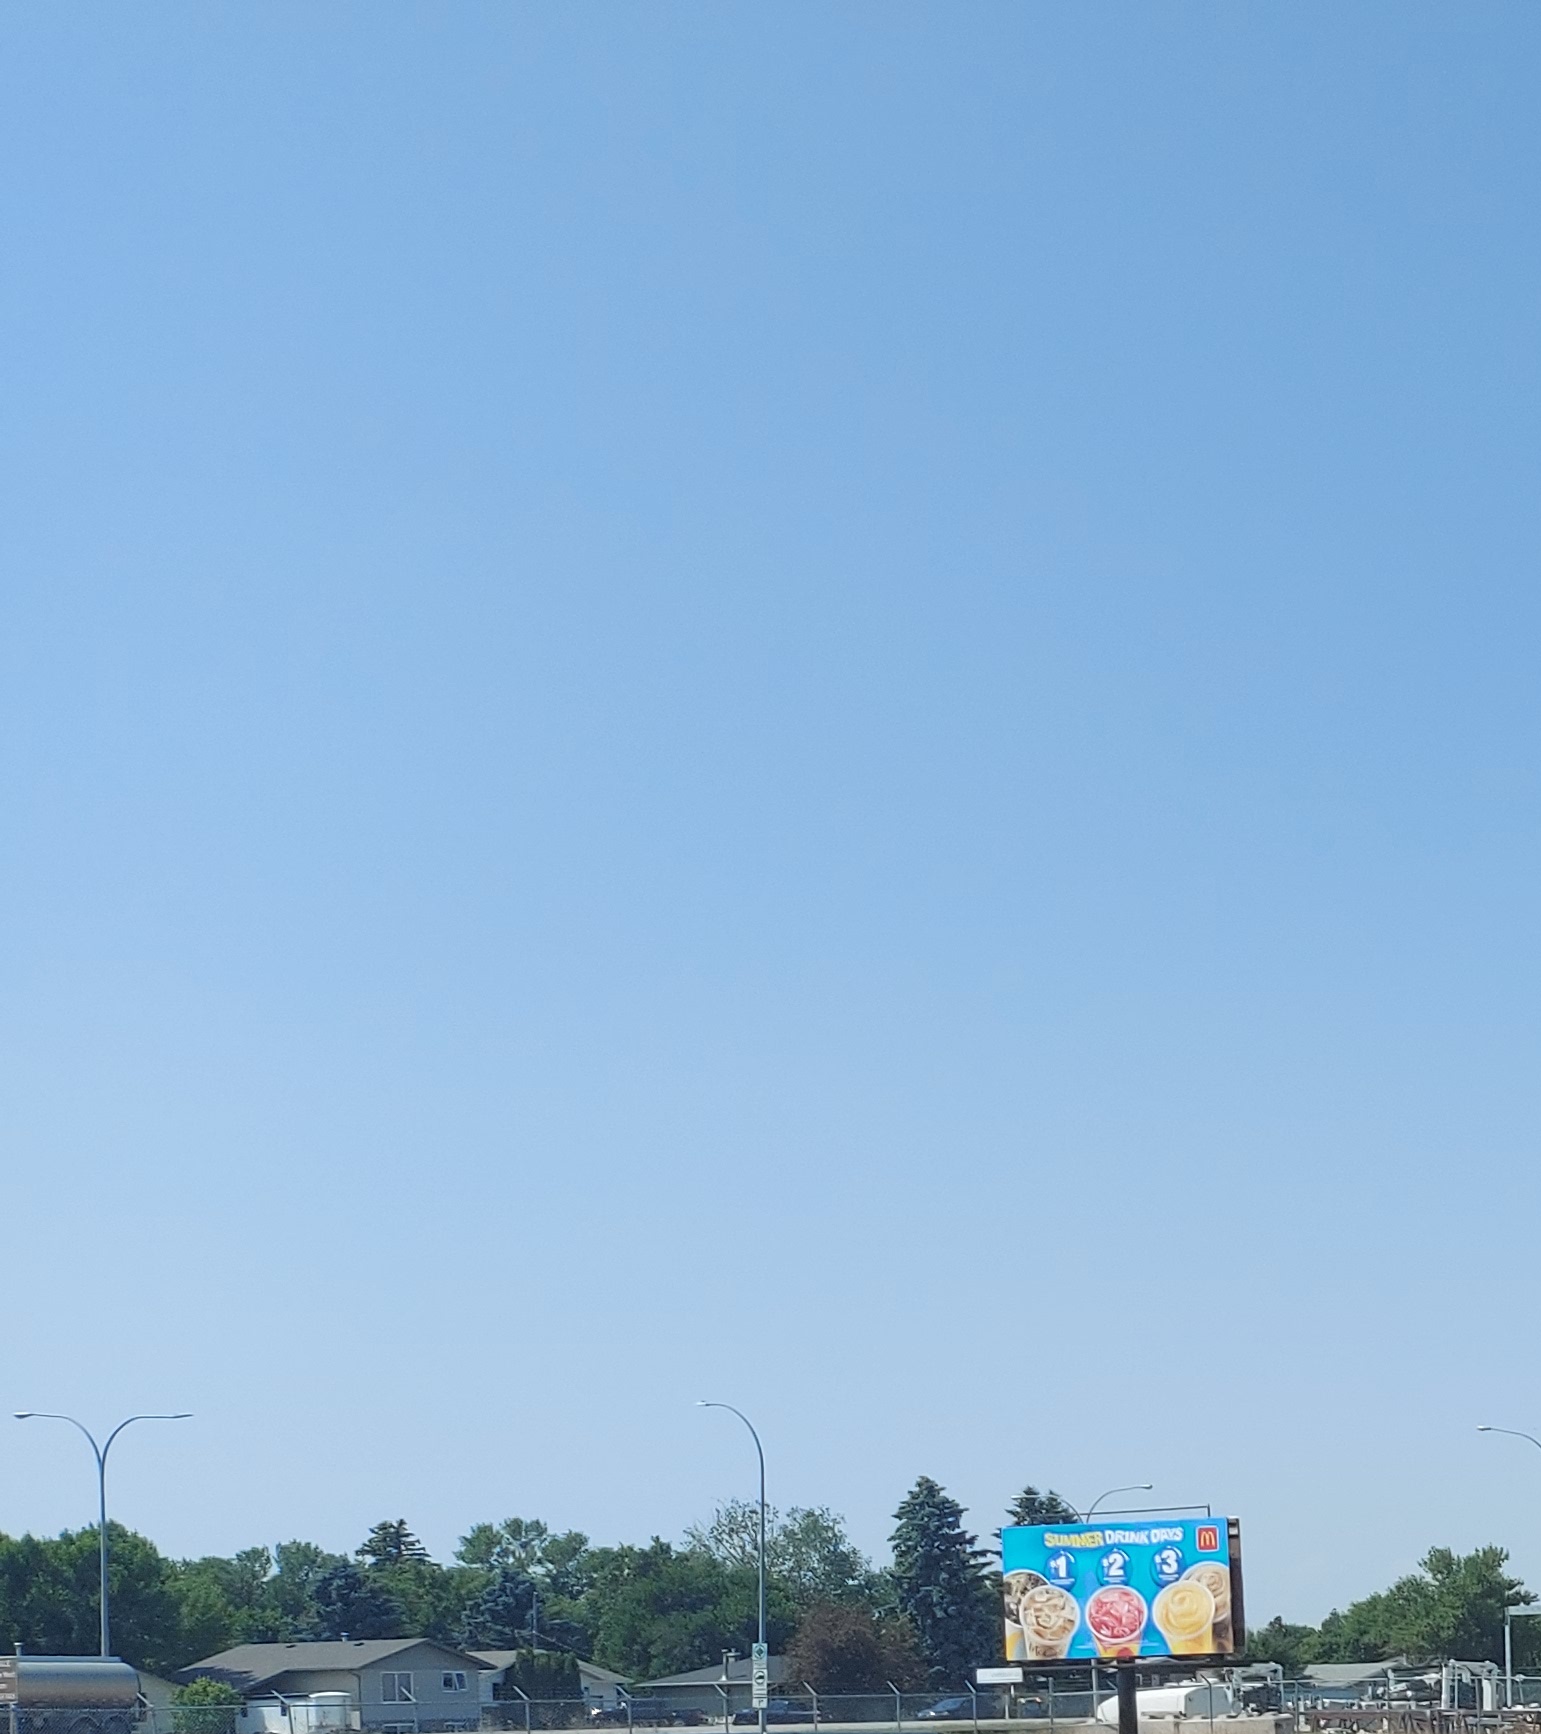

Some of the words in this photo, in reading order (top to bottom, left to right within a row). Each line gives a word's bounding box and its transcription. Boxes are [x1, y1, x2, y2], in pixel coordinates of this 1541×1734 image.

[1044, 1530, 1104, 1548] SUMMER
[1105, 1529, 1149, 1545] DRINK
[1150, 1527, 1184, 1543] DAYS
